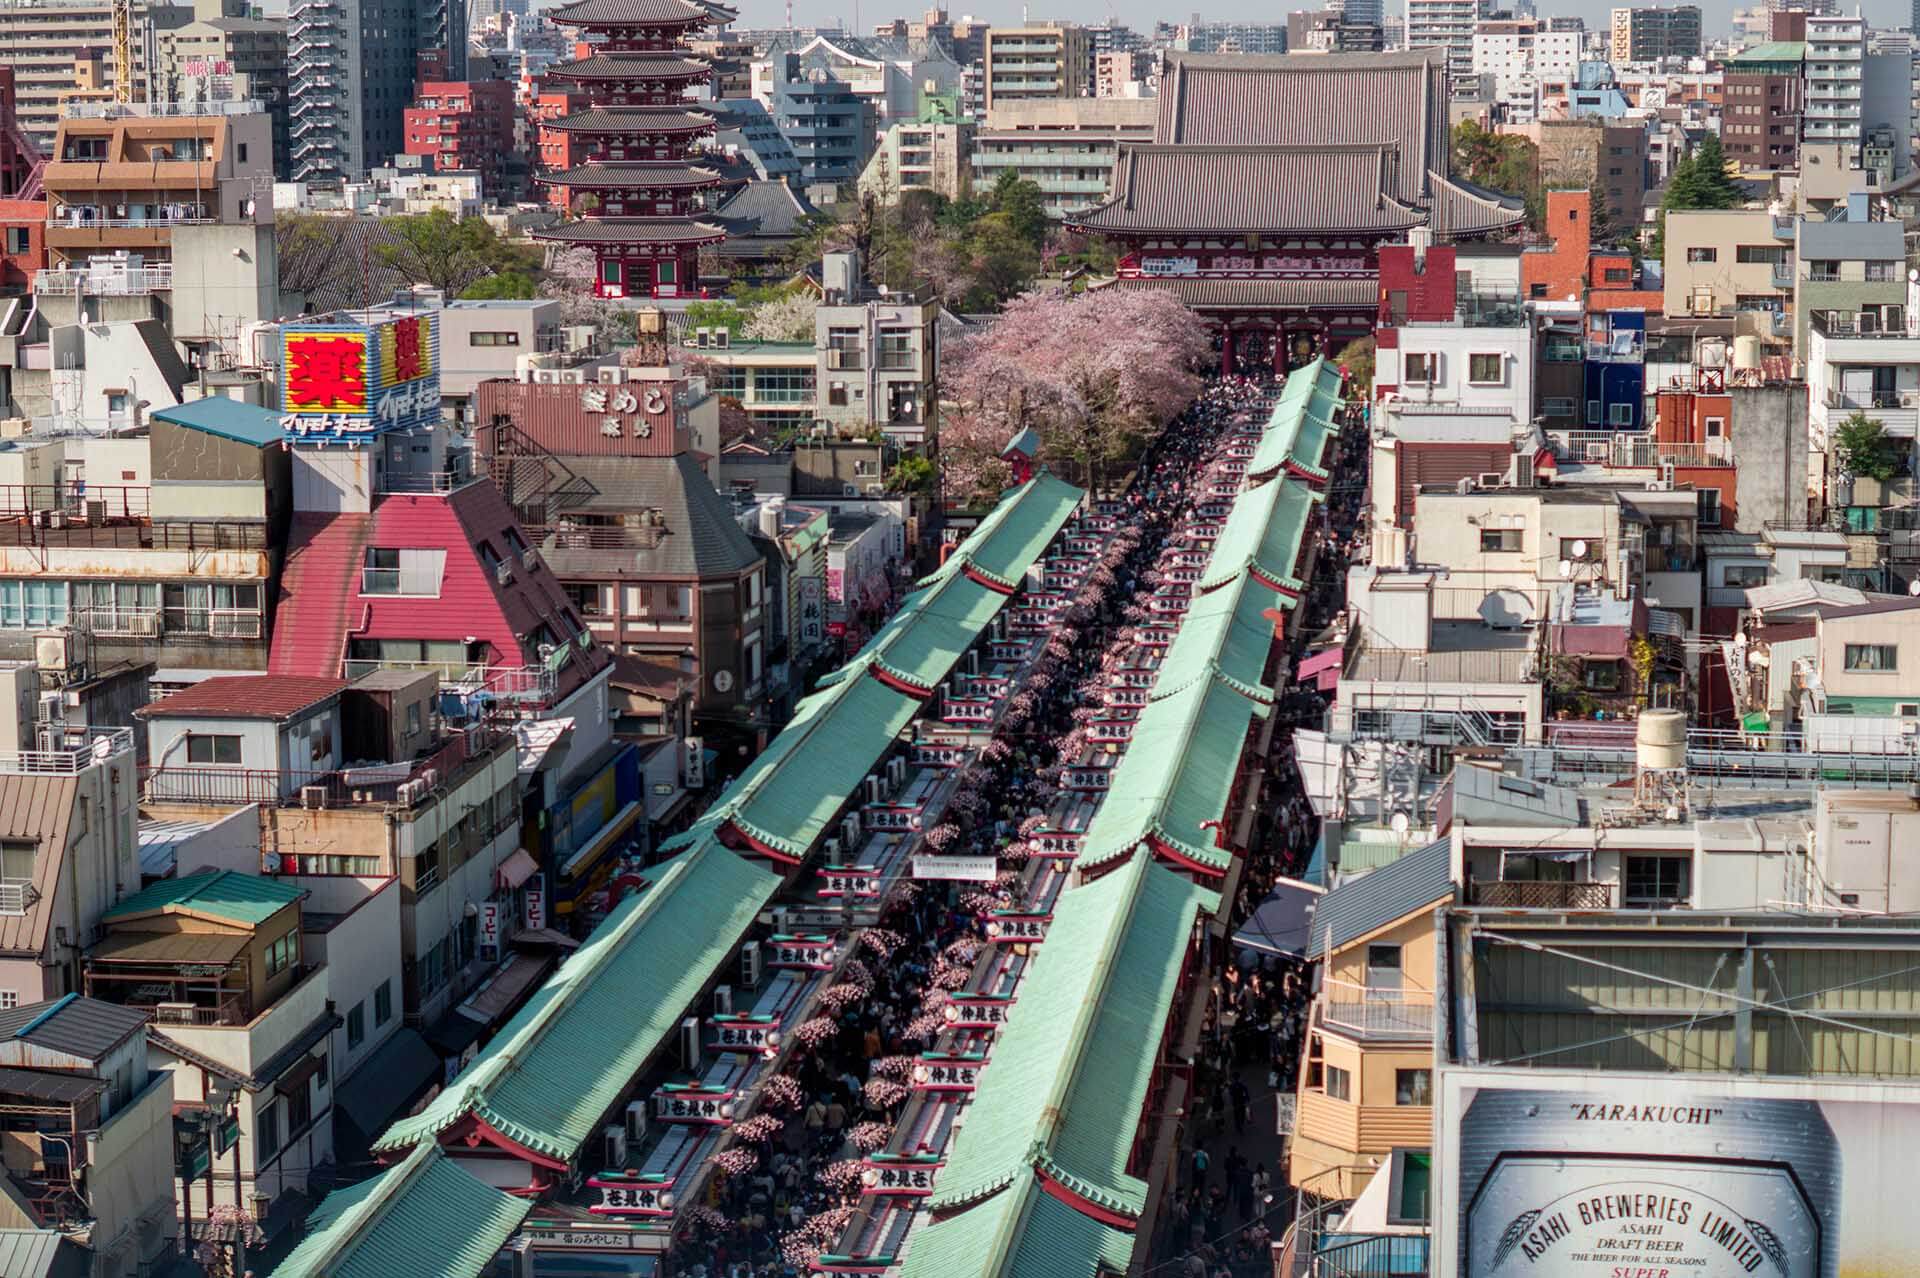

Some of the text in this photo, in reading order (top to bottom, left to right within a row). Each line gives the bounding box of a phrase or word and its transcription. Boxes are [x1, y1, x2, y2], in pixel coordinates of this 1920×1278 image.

[394, 316, 421, 381] 薬
[288, 336, 365, 408] 薬
[485, 906, 497, 941] コーヒー
[528, 892, 541, 928] コーヒー
[1520, 1194, 1763, 1273] ASAHI BREWERIES LIMITED
[1597, 1238, 1684, 1252] DRAFT BEER
[1619, 1223, 1664, 1235] ASAHI
[1570, 1253, 1707, 1266] THE BEER FOR ALL SEASONS
